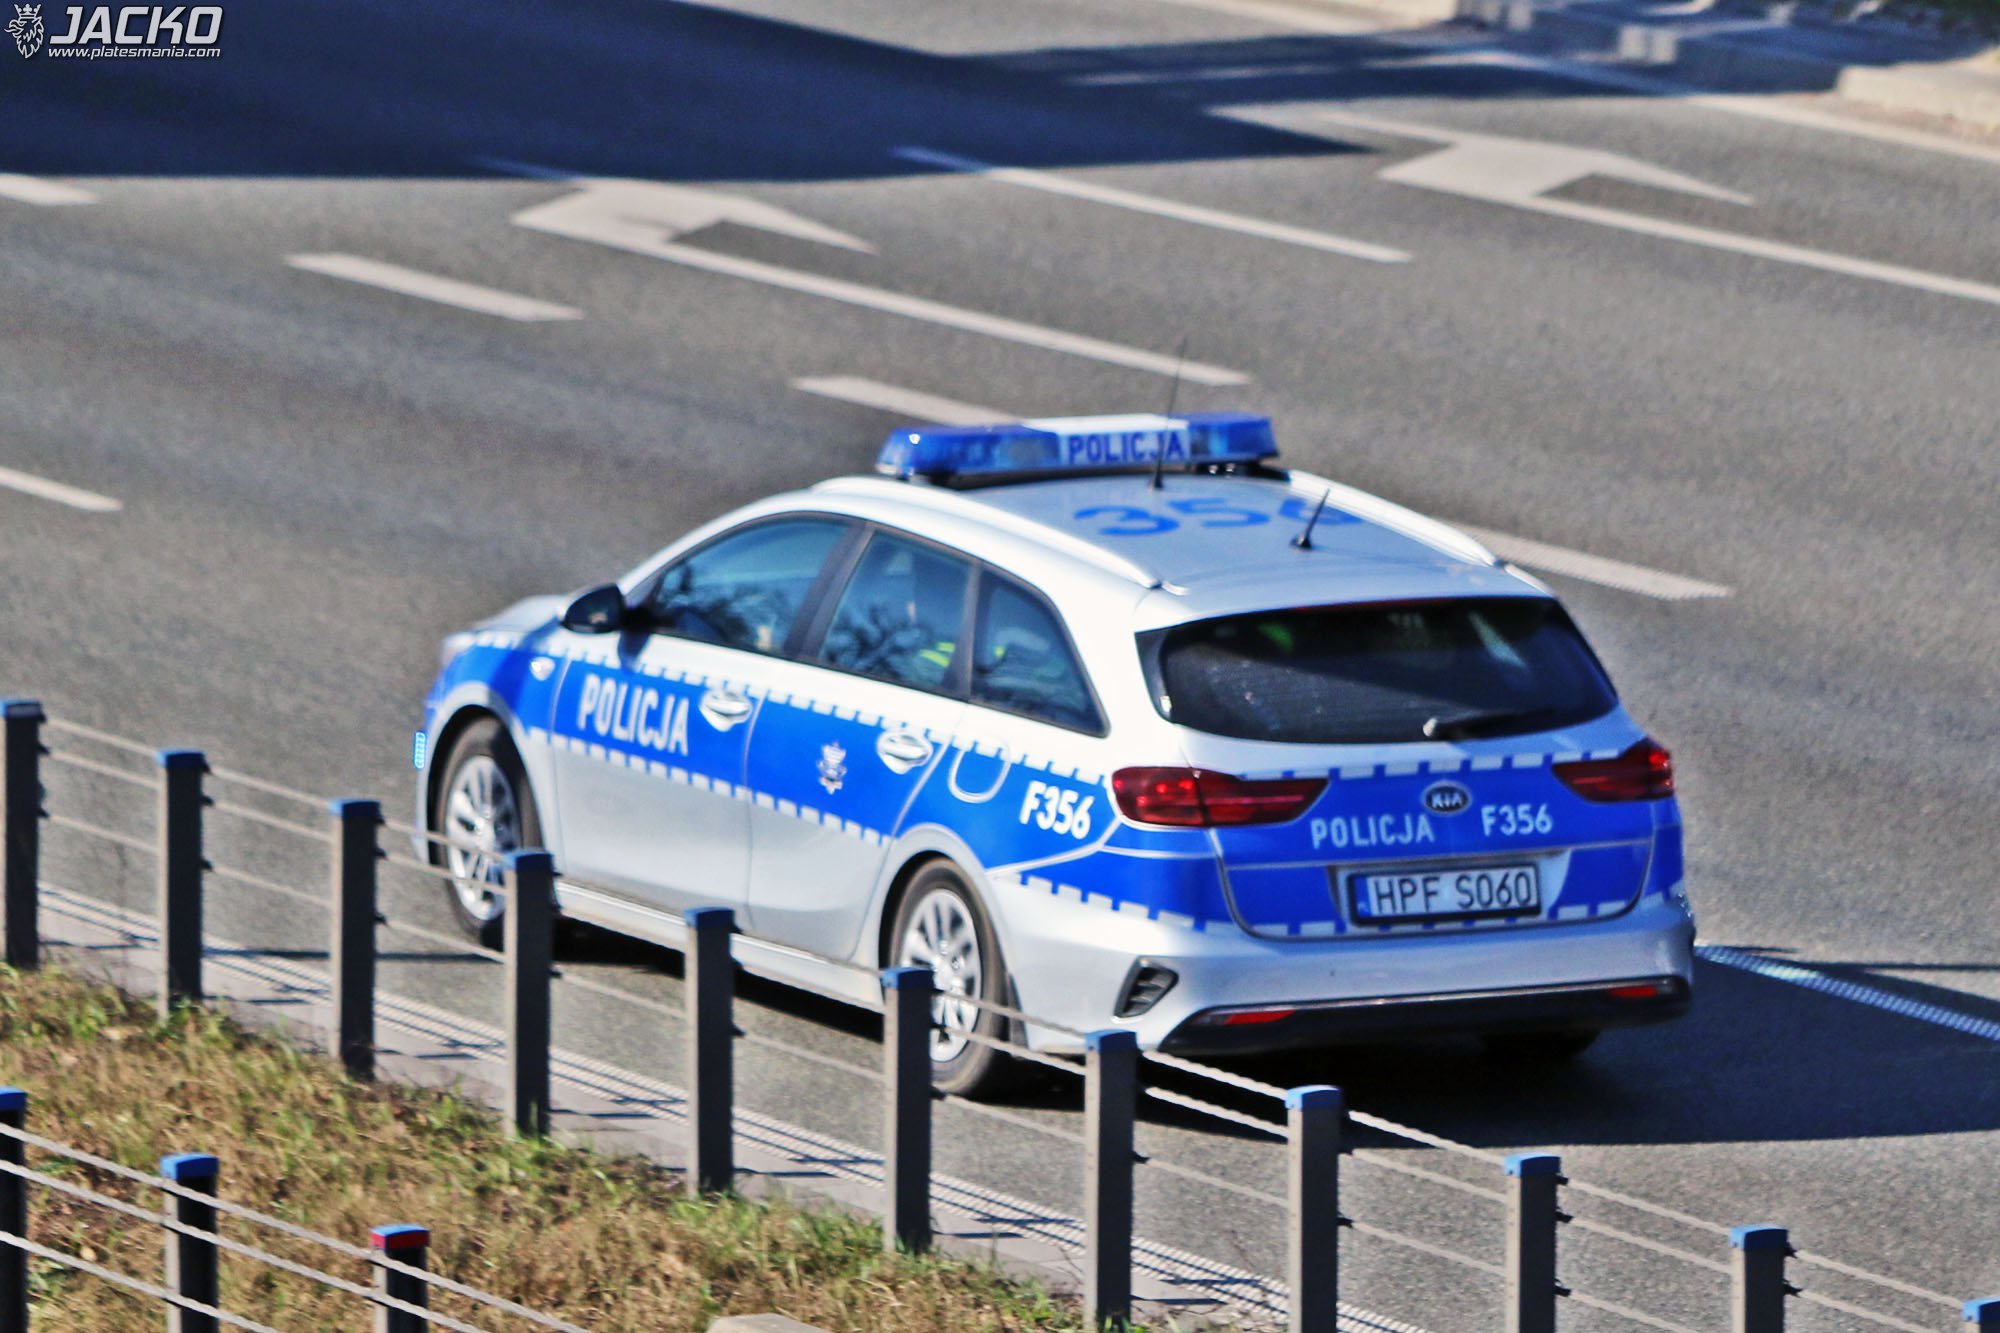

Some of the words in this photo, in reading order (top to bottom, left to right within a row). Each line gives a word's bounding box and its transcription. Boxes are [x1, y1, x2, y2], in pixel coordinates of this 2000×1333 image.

[1068, 433, 1186, 464] POLICJA
[577, 673, 689, 757] POLICJA
[1019, 780, 1094, 840] F356
[1432, 793, 1463, 808] KIA
[1311, 814, 1435, 850] POLICJA
[1480, 803, 1553, 837] F356
[1374, 876, 1441, 914] HPF
[1455, 871, 1533, 909] S060
